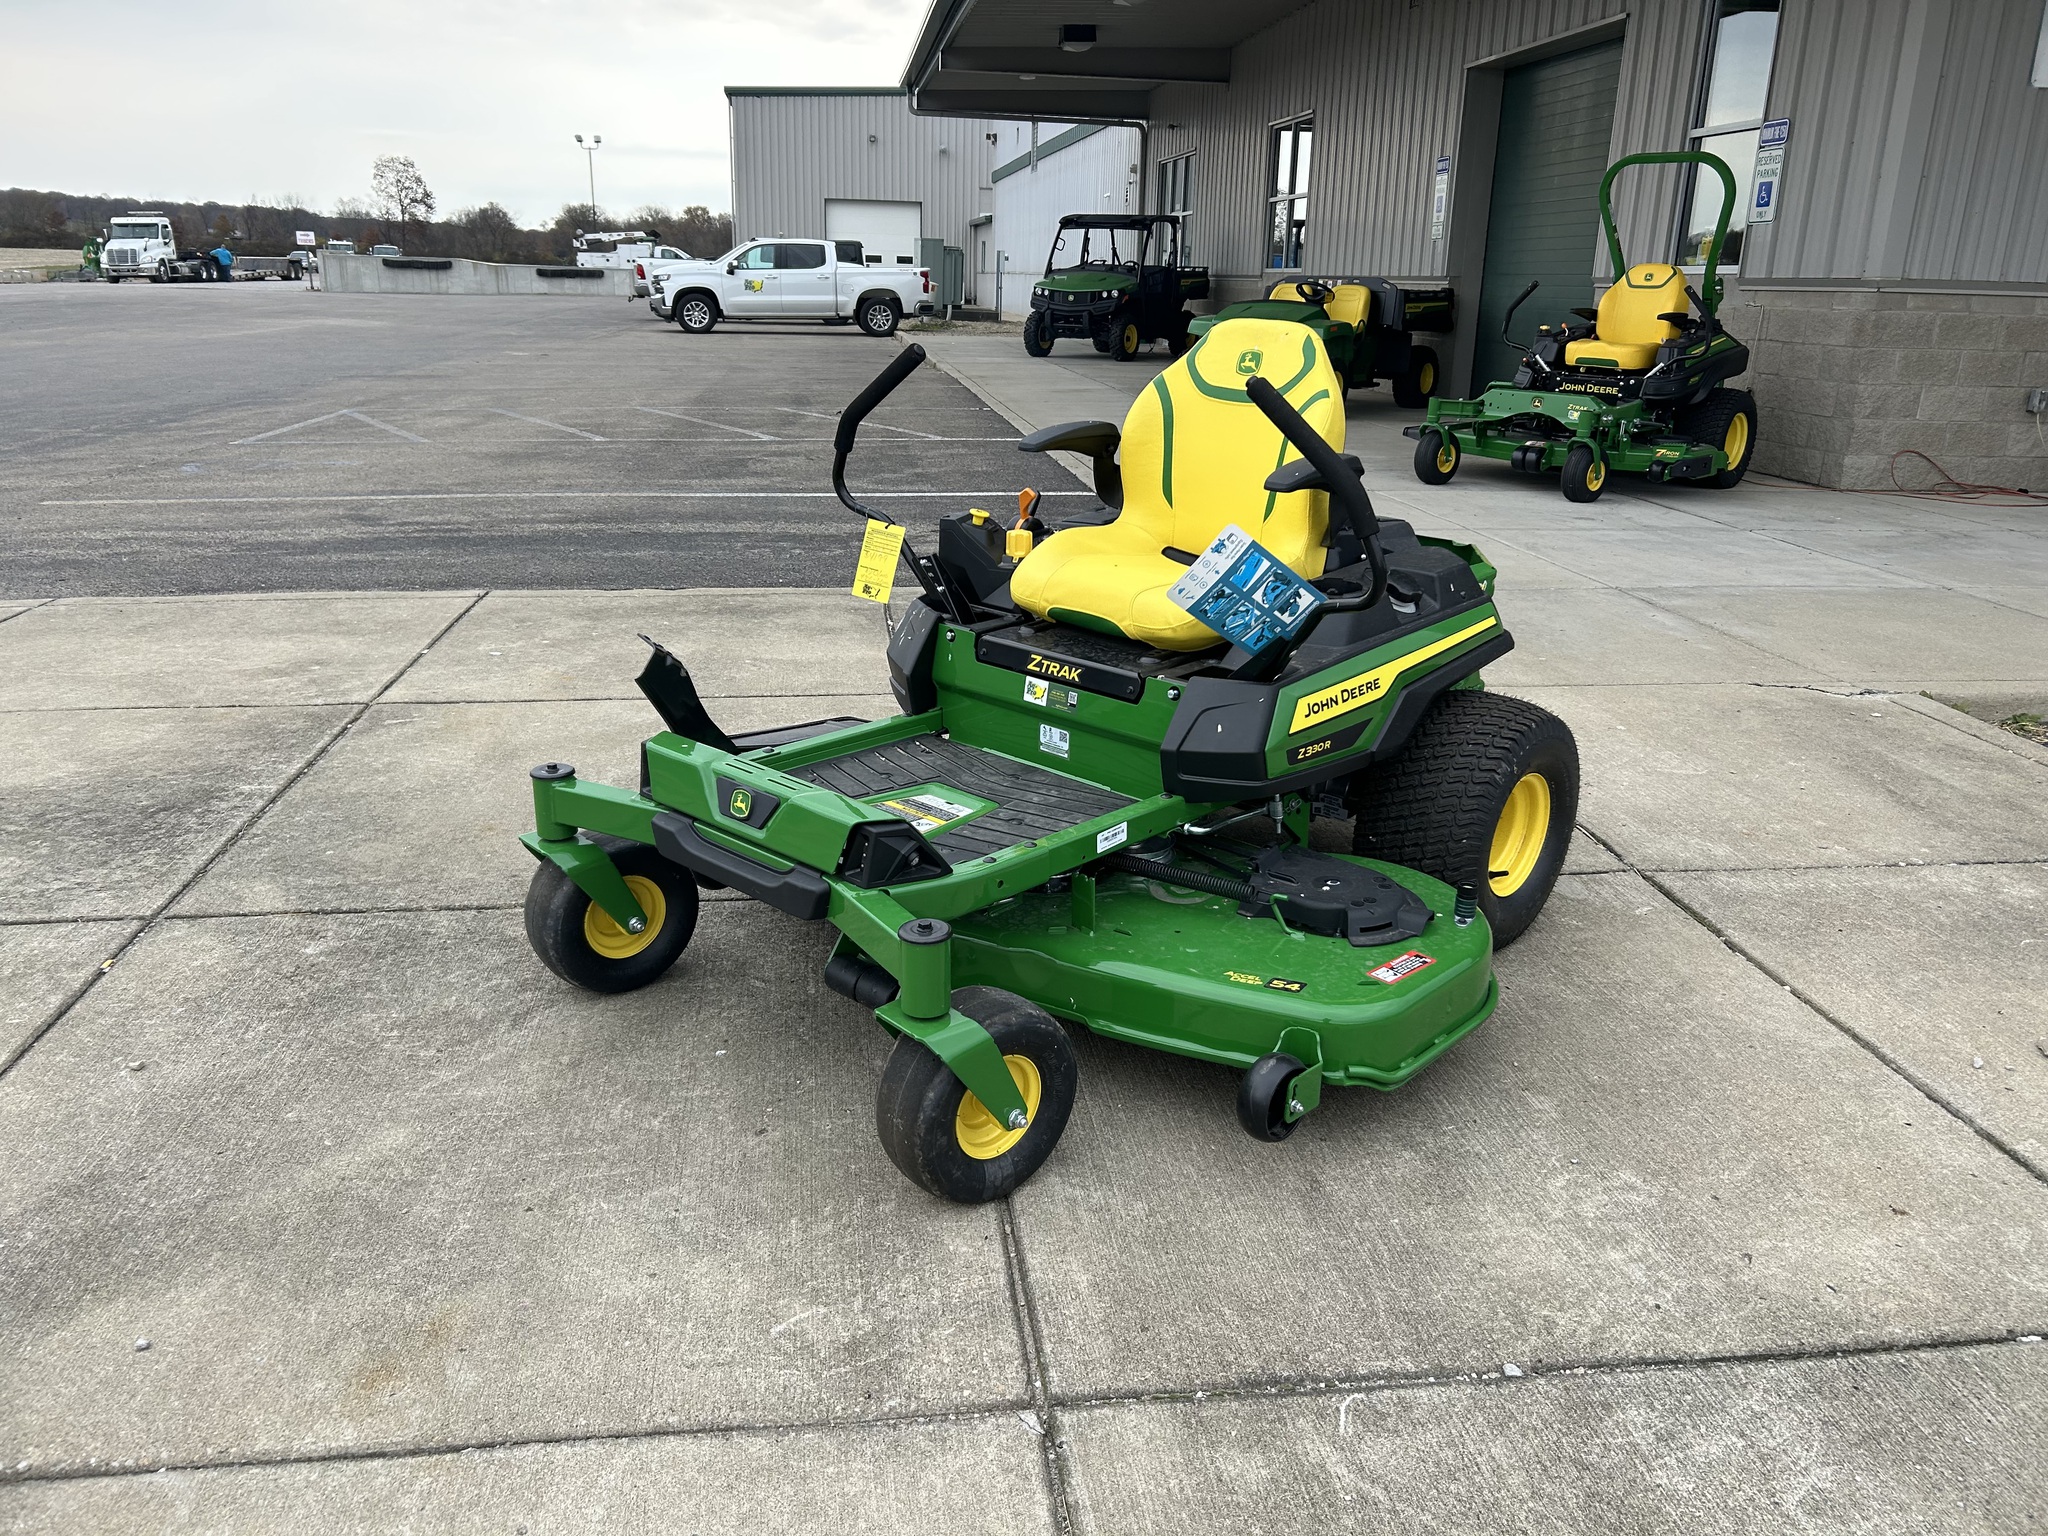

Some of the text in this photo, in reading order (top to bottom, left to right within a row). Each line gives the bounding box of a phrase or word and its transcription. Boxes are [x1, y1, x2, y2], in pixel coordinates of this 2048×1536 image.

[1758, 154, 1781, 166] RESERVED
[1756, 167, 1779, 179] PARKING
[1559, 381, 1619, 395] JOHN DEERE
[1027, 654, 1082, 682] ZTRAK
[1304, 677, 1381, 718] JOHN DEERE
[1223, 971, 1261, 981] ACCEL
[1269, 980, 1301, 991] 54
